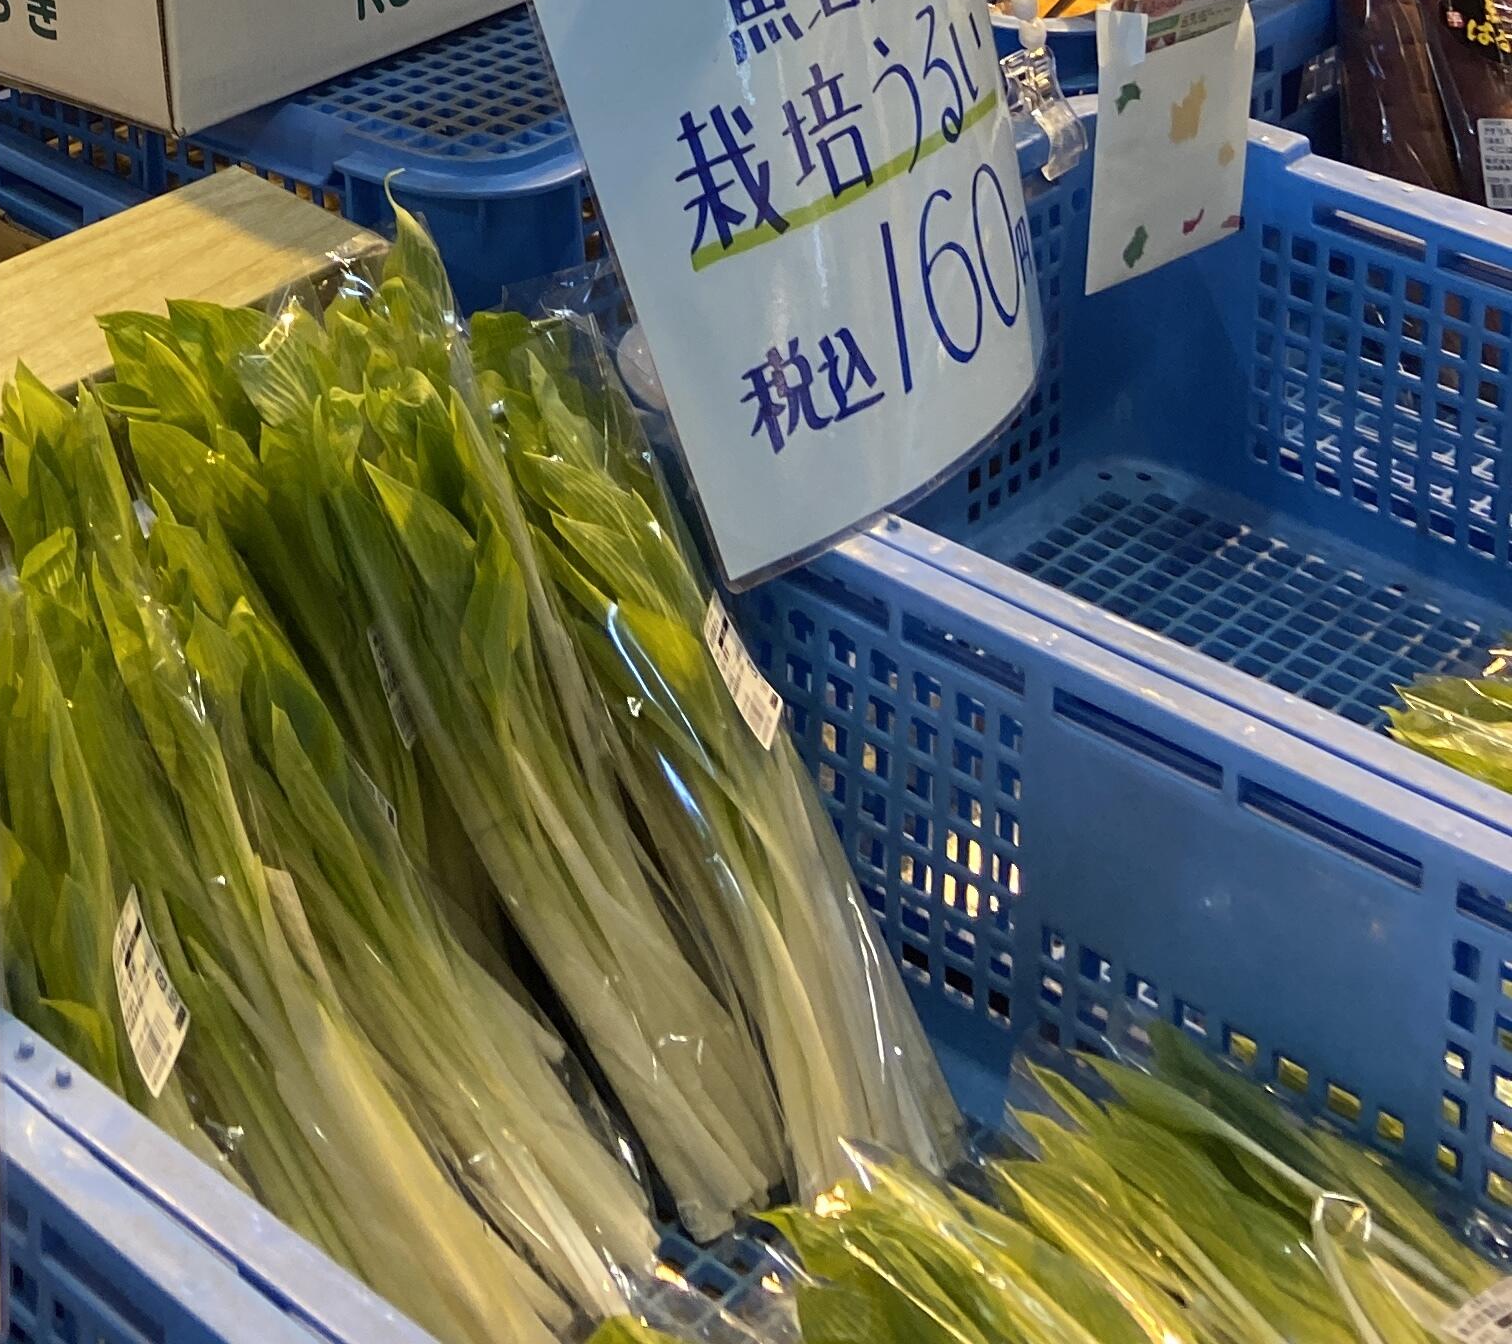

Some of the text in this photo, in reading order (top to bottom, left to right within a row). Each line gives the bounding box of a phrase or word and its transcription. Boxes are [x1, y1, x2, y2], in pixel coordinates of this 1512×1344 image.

[676, 4, 983, 255] 栽培うるい
